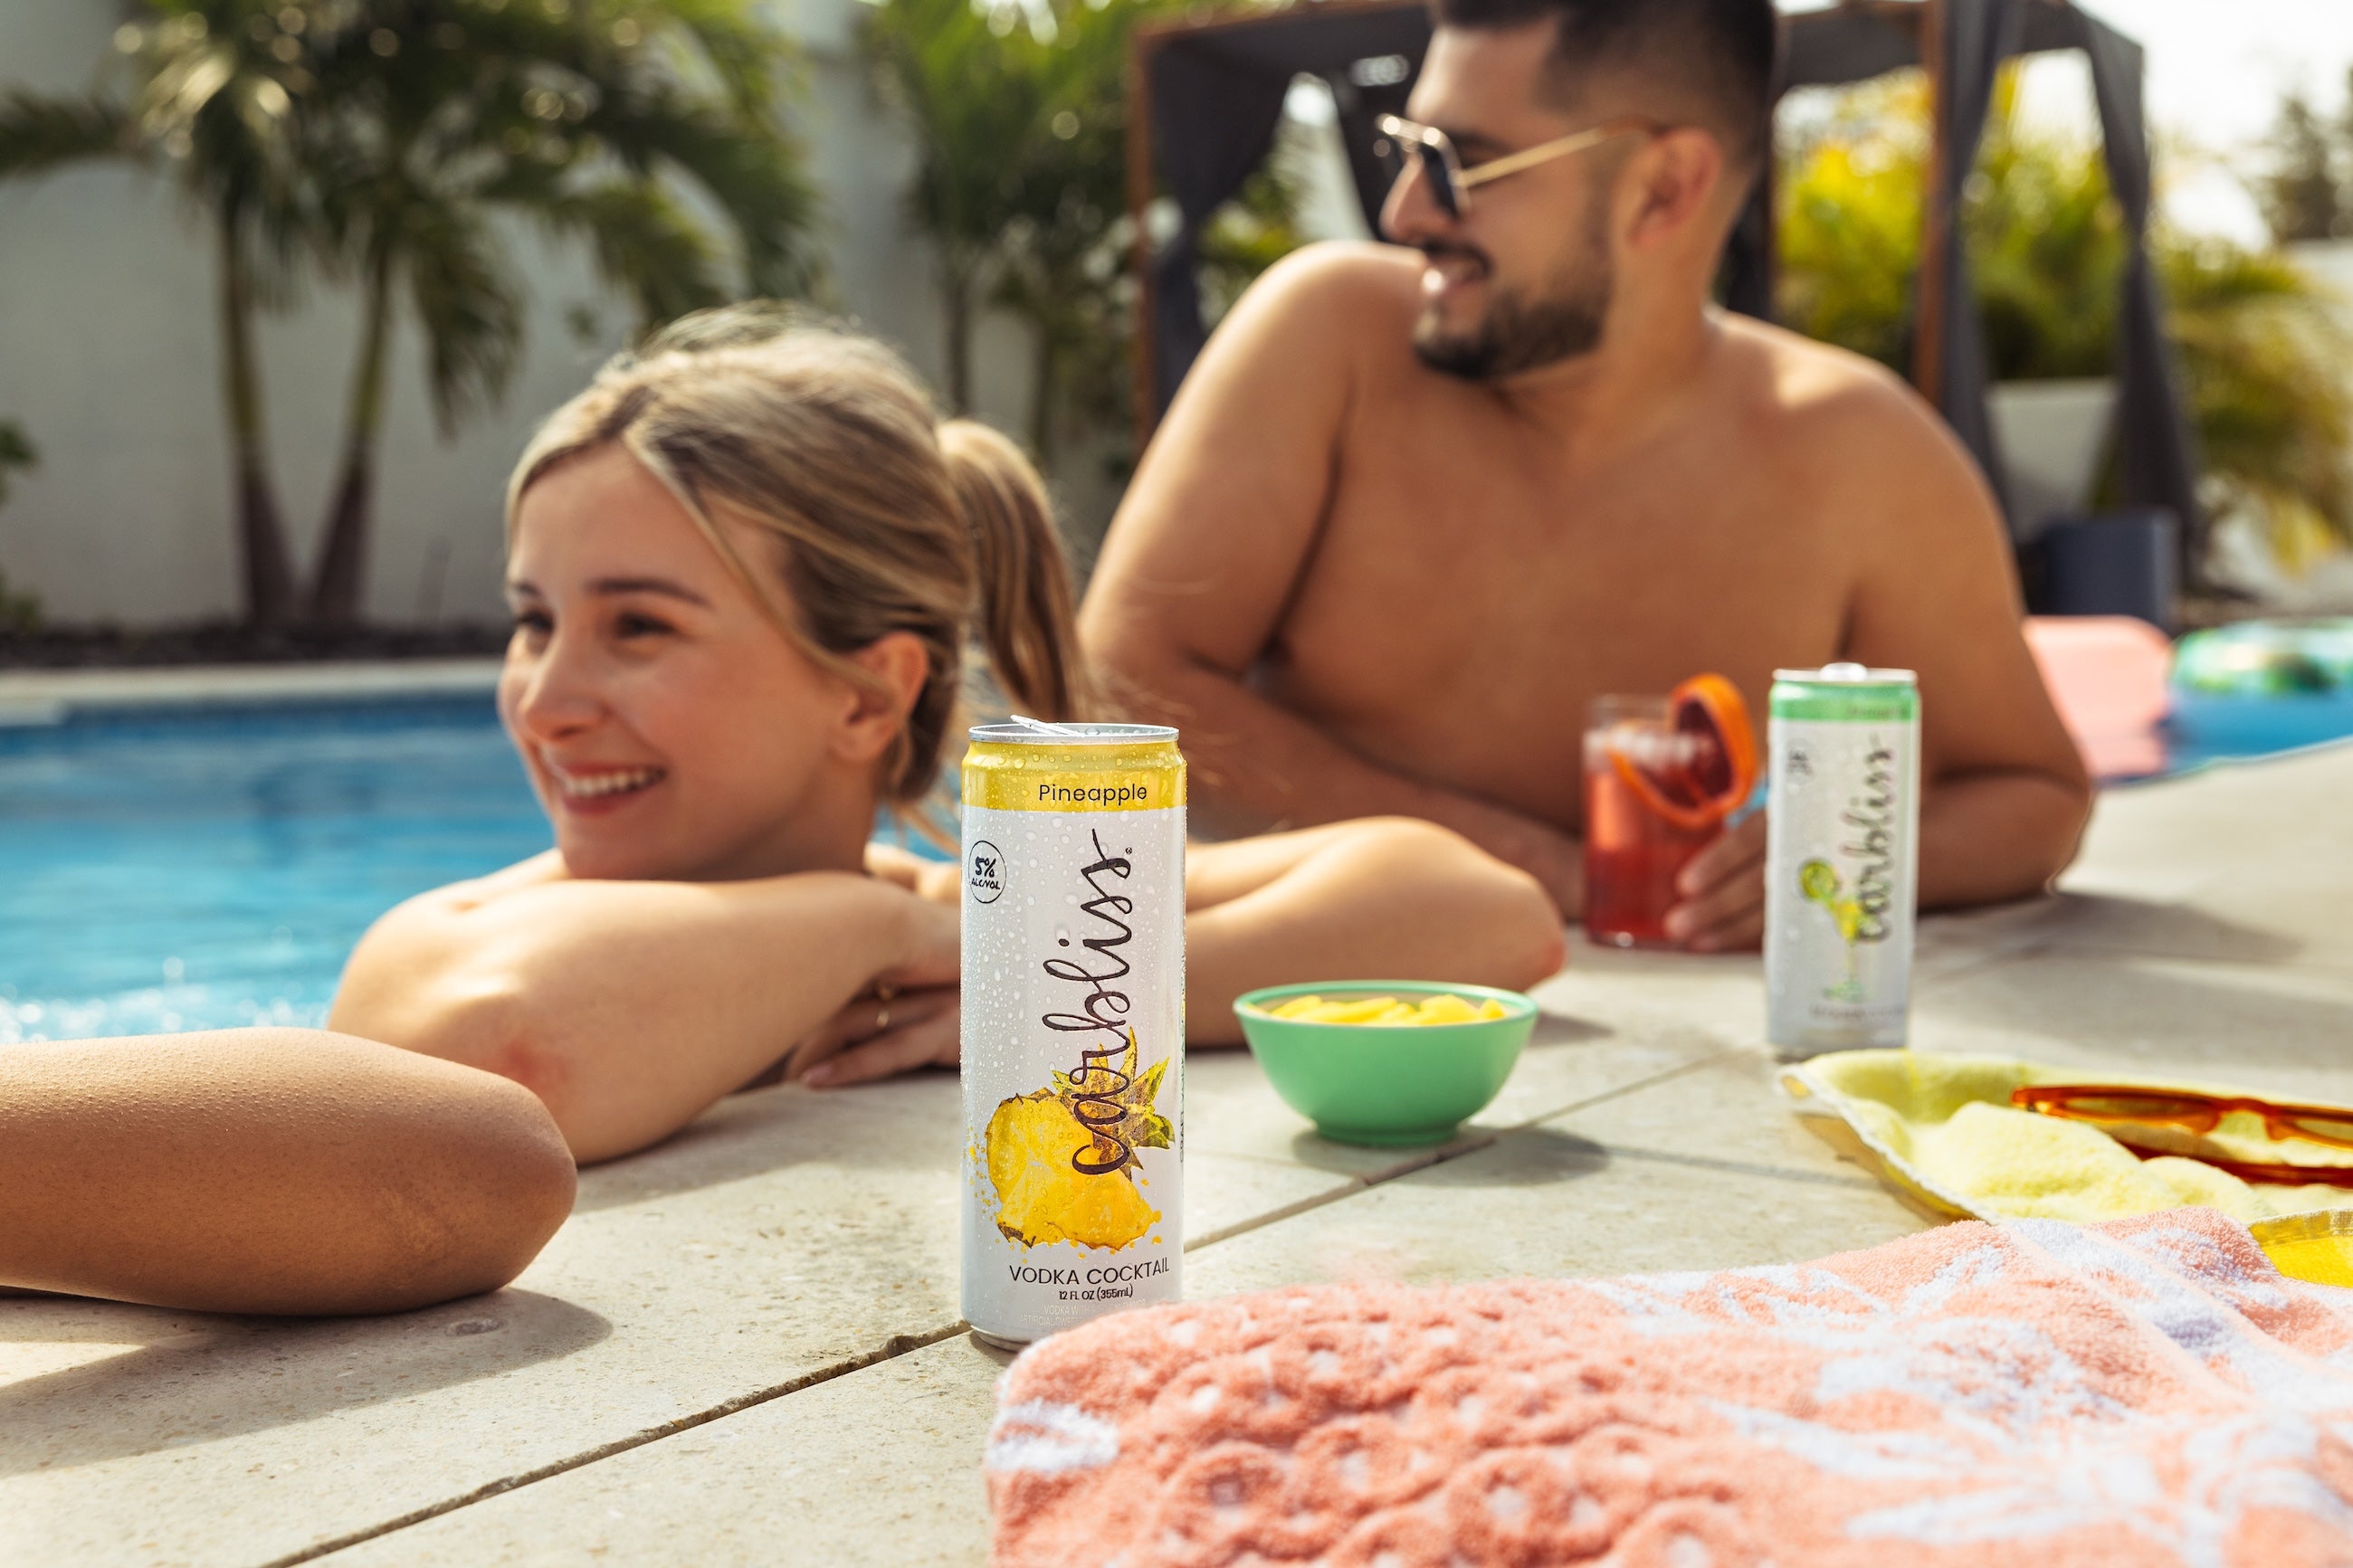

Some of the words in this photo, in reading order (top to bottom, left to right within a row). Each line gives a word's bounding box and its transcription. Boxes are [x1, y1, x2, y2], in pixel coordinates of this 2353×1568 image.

[1039, 784, 1148, 806] Pineapple
[975, 856, 996, 878] 5%
[1042, 828, 1133, 1175] carbliss
[1009, 1265, 1080, 1285] VODKA
[1086, 1257, 1170, 1285] COCKTAIL
[1059, 1290, 1068, 1300] 12
[1081, 1290, 1095, 1300] OZ
[1096, 1283, 1134, 1302] (355mL)
[1043, 1305, 1071, 1316] VODKA
